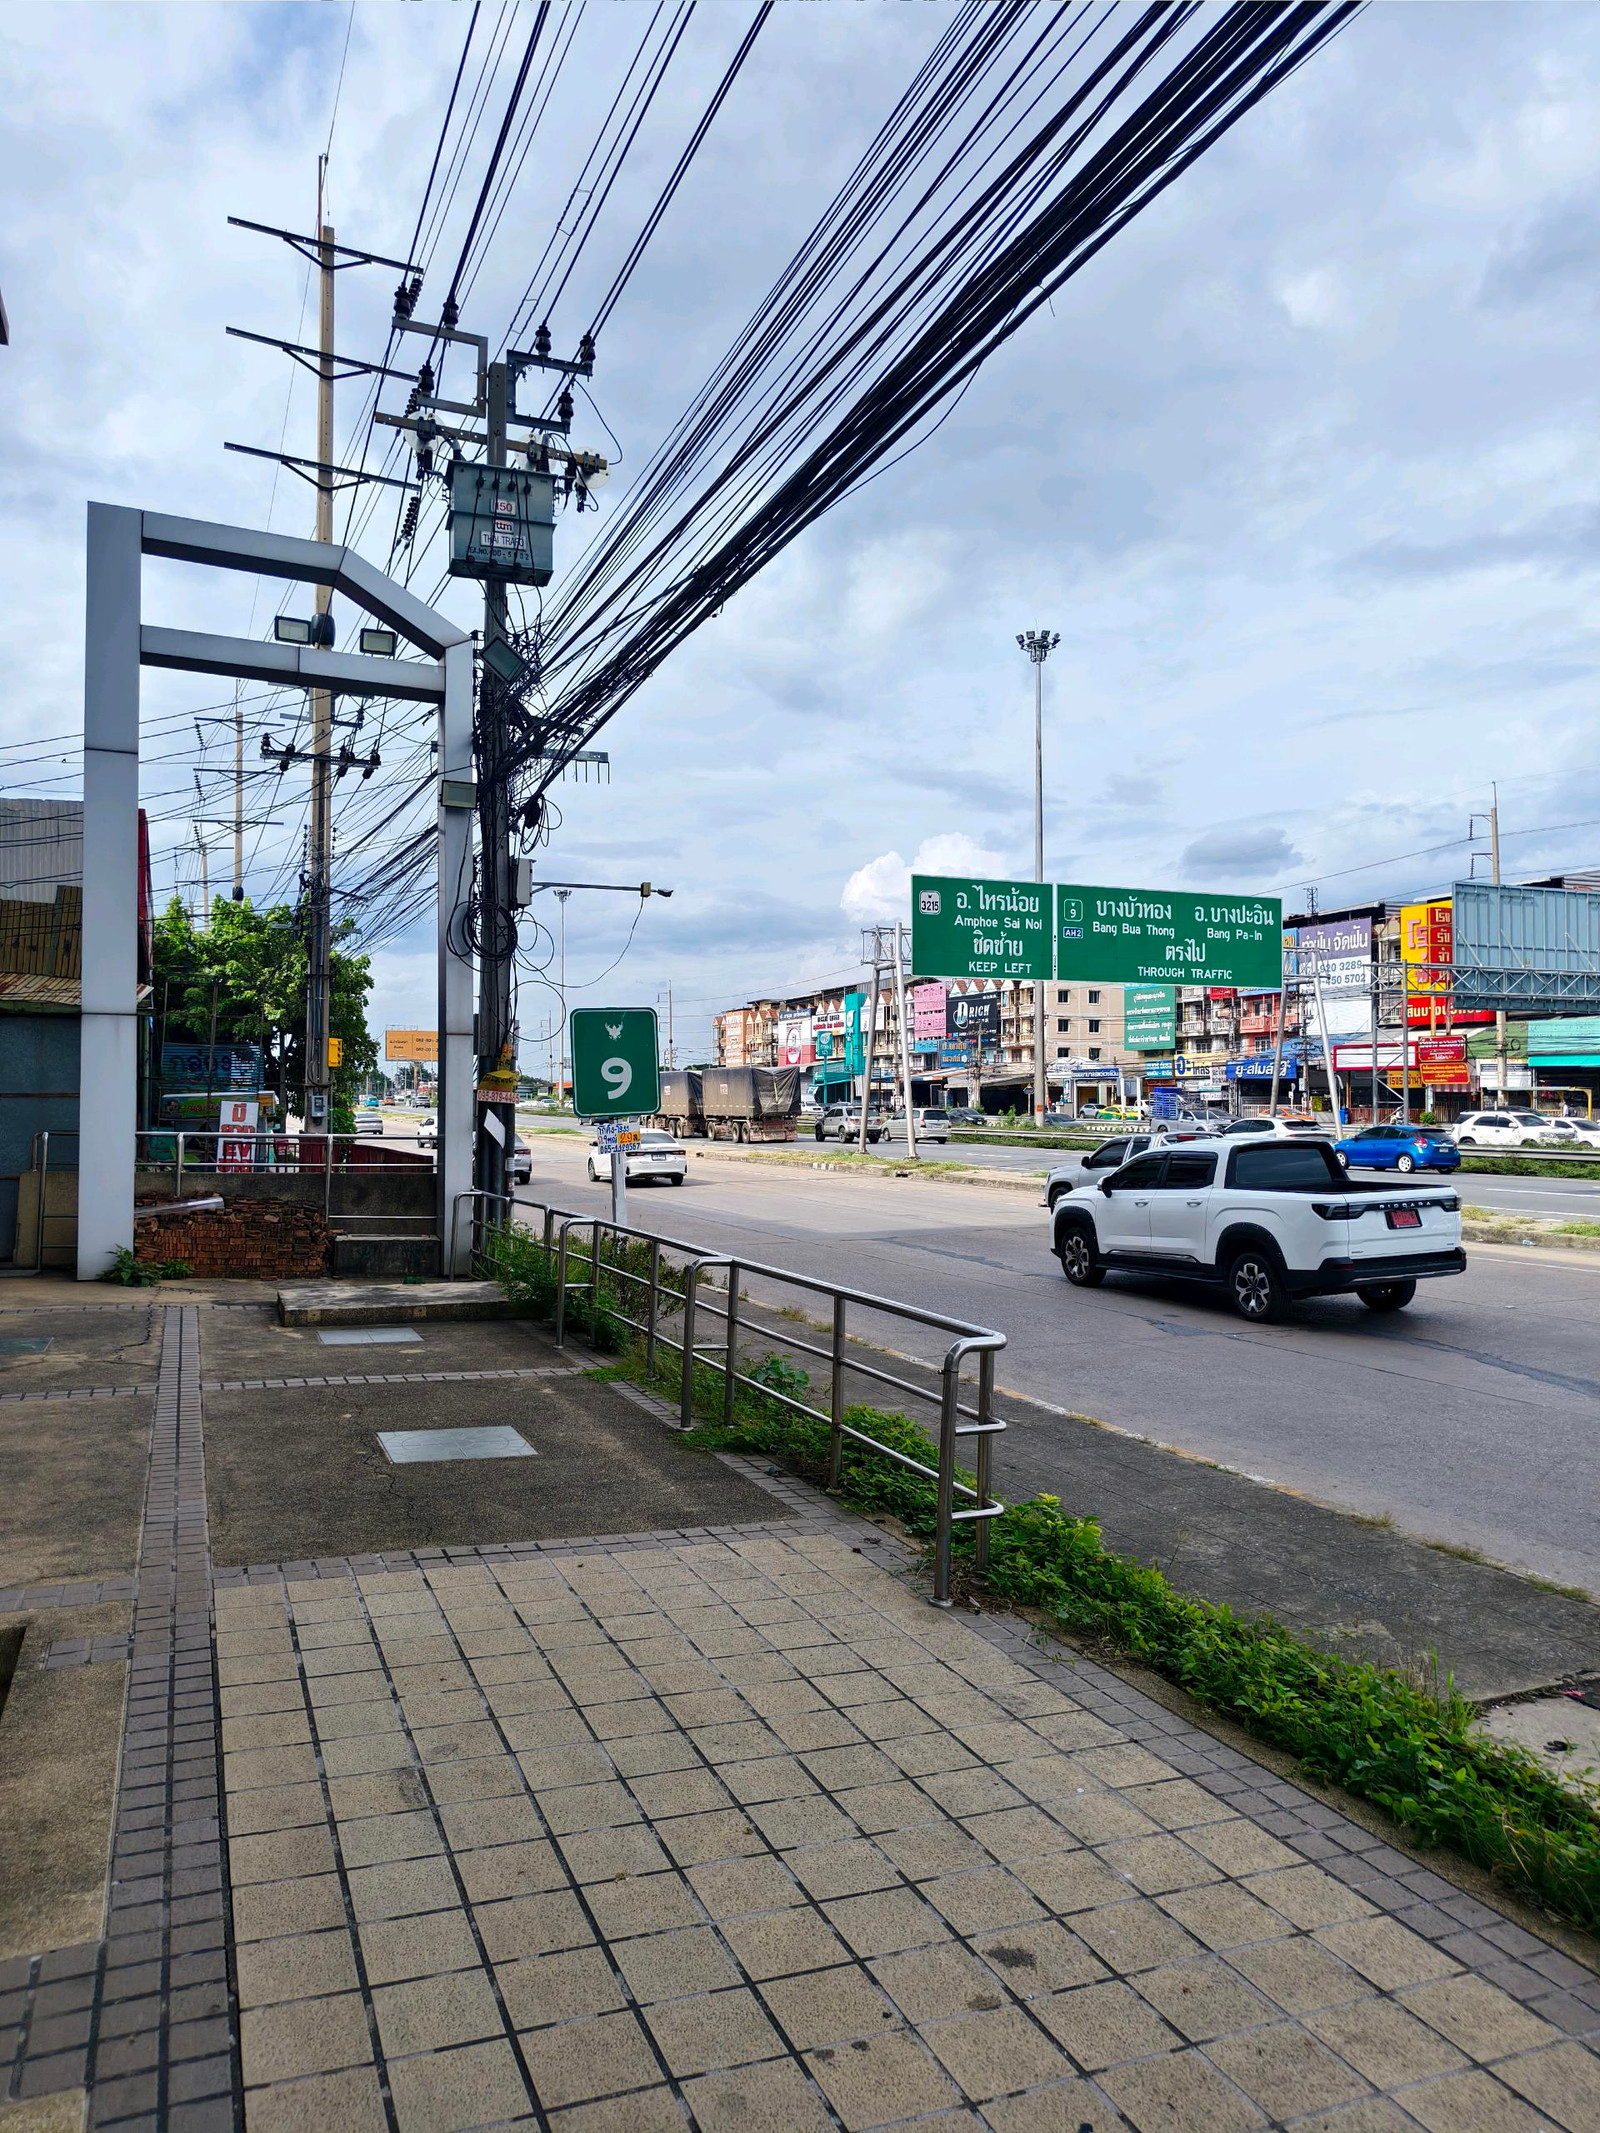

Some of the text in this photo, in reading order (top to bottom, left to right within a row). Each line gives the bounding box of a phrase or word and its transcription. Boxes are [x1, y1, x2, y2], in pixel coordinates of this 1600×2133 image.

[921, 900, 939, 912] 3215
[1070, 909, 1076, 919] 9
[1096, 896, 1171, 920] บางบัวทอง
[954, 915, 1042, 930] Amphoe Sai Noi
[1194, 903, 1274, 926] อ.บางปะอิน
[1065, 929, 1082, 937] AH2
[1092, 921, 1175, 938] Bang Bua Thong
[1207, 928, 1262, 941] Bang Pa-In
[973, 929, 1023, 956] ชิดซ้าย
[1333, 925, 1368, 951] จัดฟัน
[1165, 939, 1206, 962] ตรงไป
[968, 961, 1032, 974] KEEP LEFT
[1137, 966, 1233, 980] THROUGH TRAFFIC
[601, 1057, 632, 1100] 9
